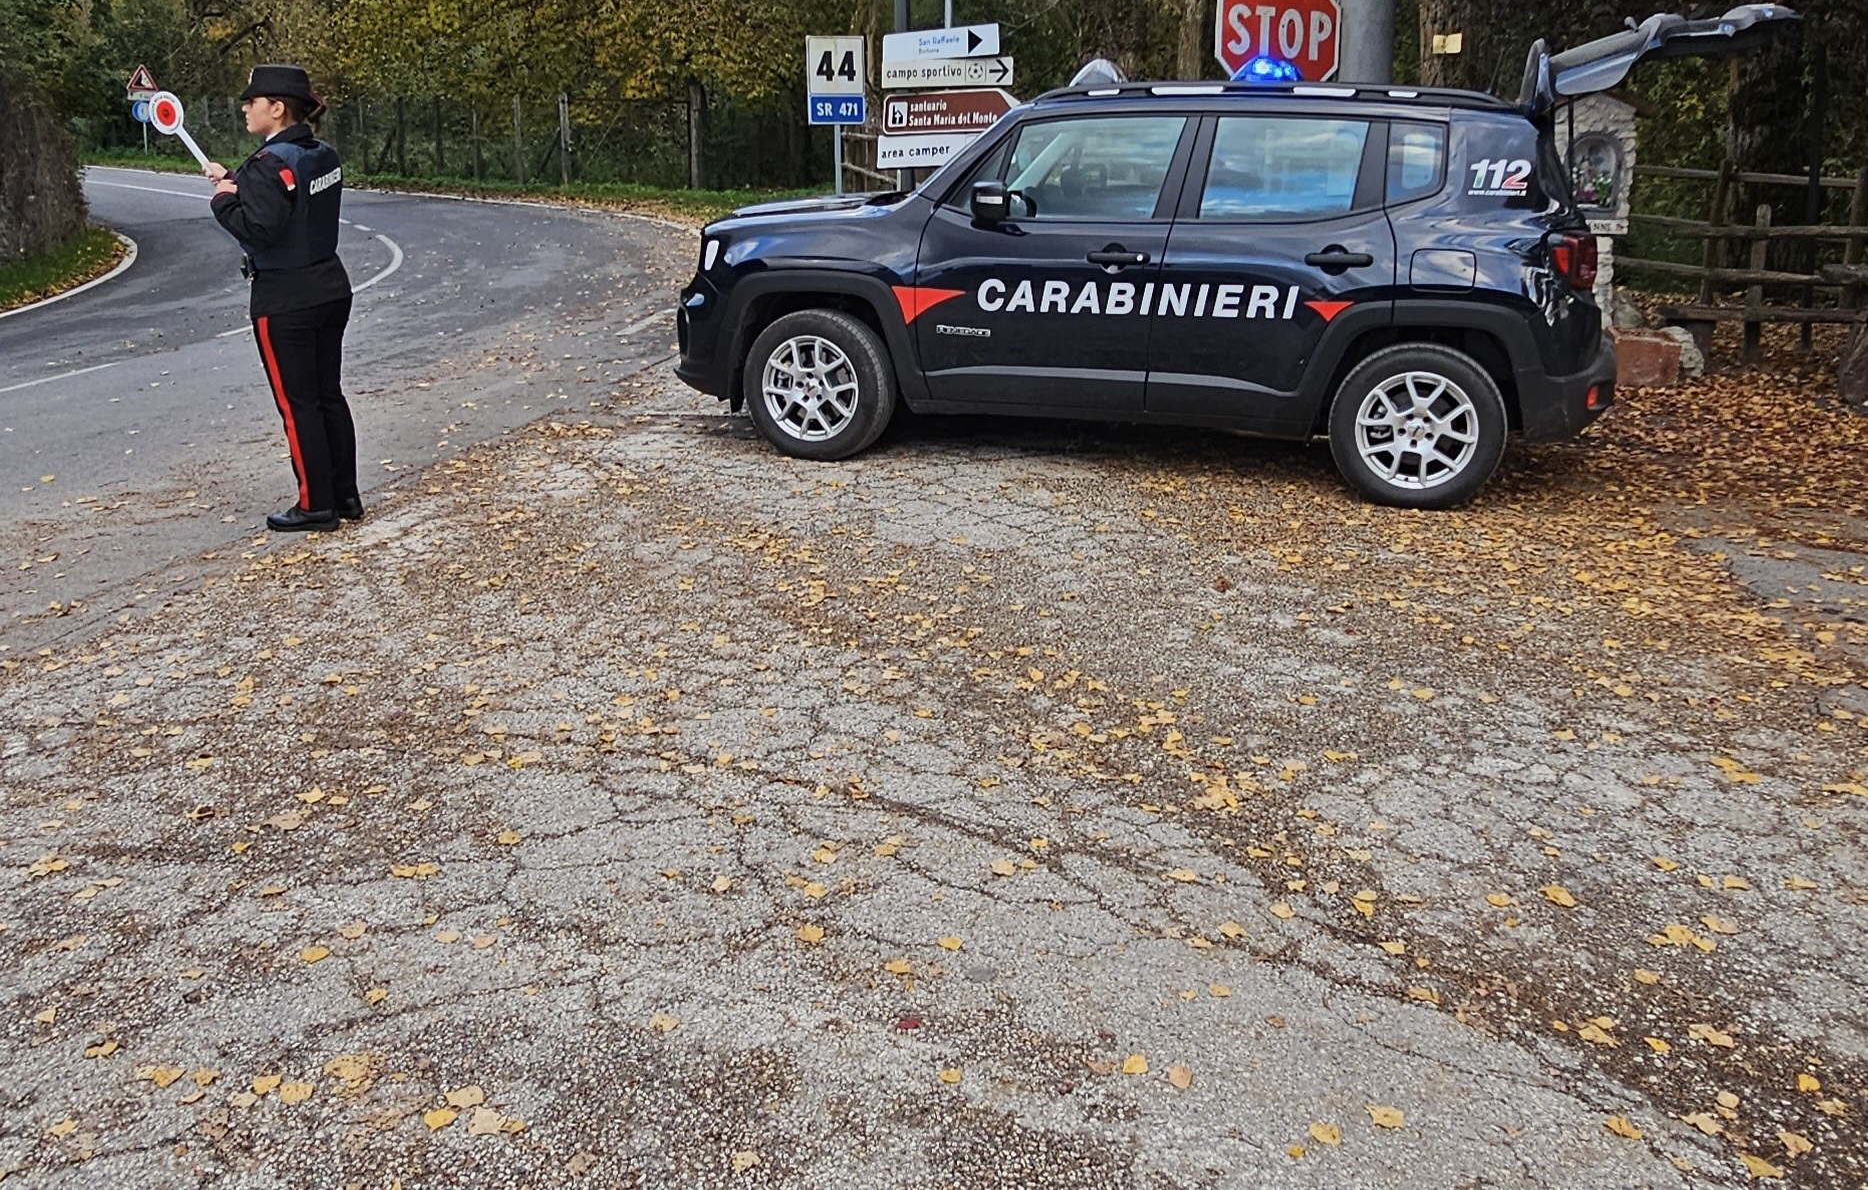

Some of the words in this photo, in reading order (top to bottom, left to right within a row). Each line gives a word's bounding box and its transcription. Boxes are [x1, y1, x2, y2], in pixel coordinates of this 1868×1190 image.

[918, 37, 931, 46] San
[932, 35, 960, 45] Raffaele
[1226, 3, 1333, 62] STOP
[816, 50, 857, 82] 44
[886, 68, 918, 81] campo
[921, 65, 962, 79] sportivo
[816, 103, 832, 117] SR
[839, 102, 858, 116] 471
[910, 99, 947, 112] santuario
[908, 115, 932, 127] Santa
[933, 113, 956, 125] Maria
[957, 112, 971, 126] del
[972, 111, 998, 124] Monte
[881, 148, 904, 159] area
[908, 145, 950, 157] camper
[1469, 158, 1532, 189] 112
[976, 276, 1301, 321] CARABINIERI
